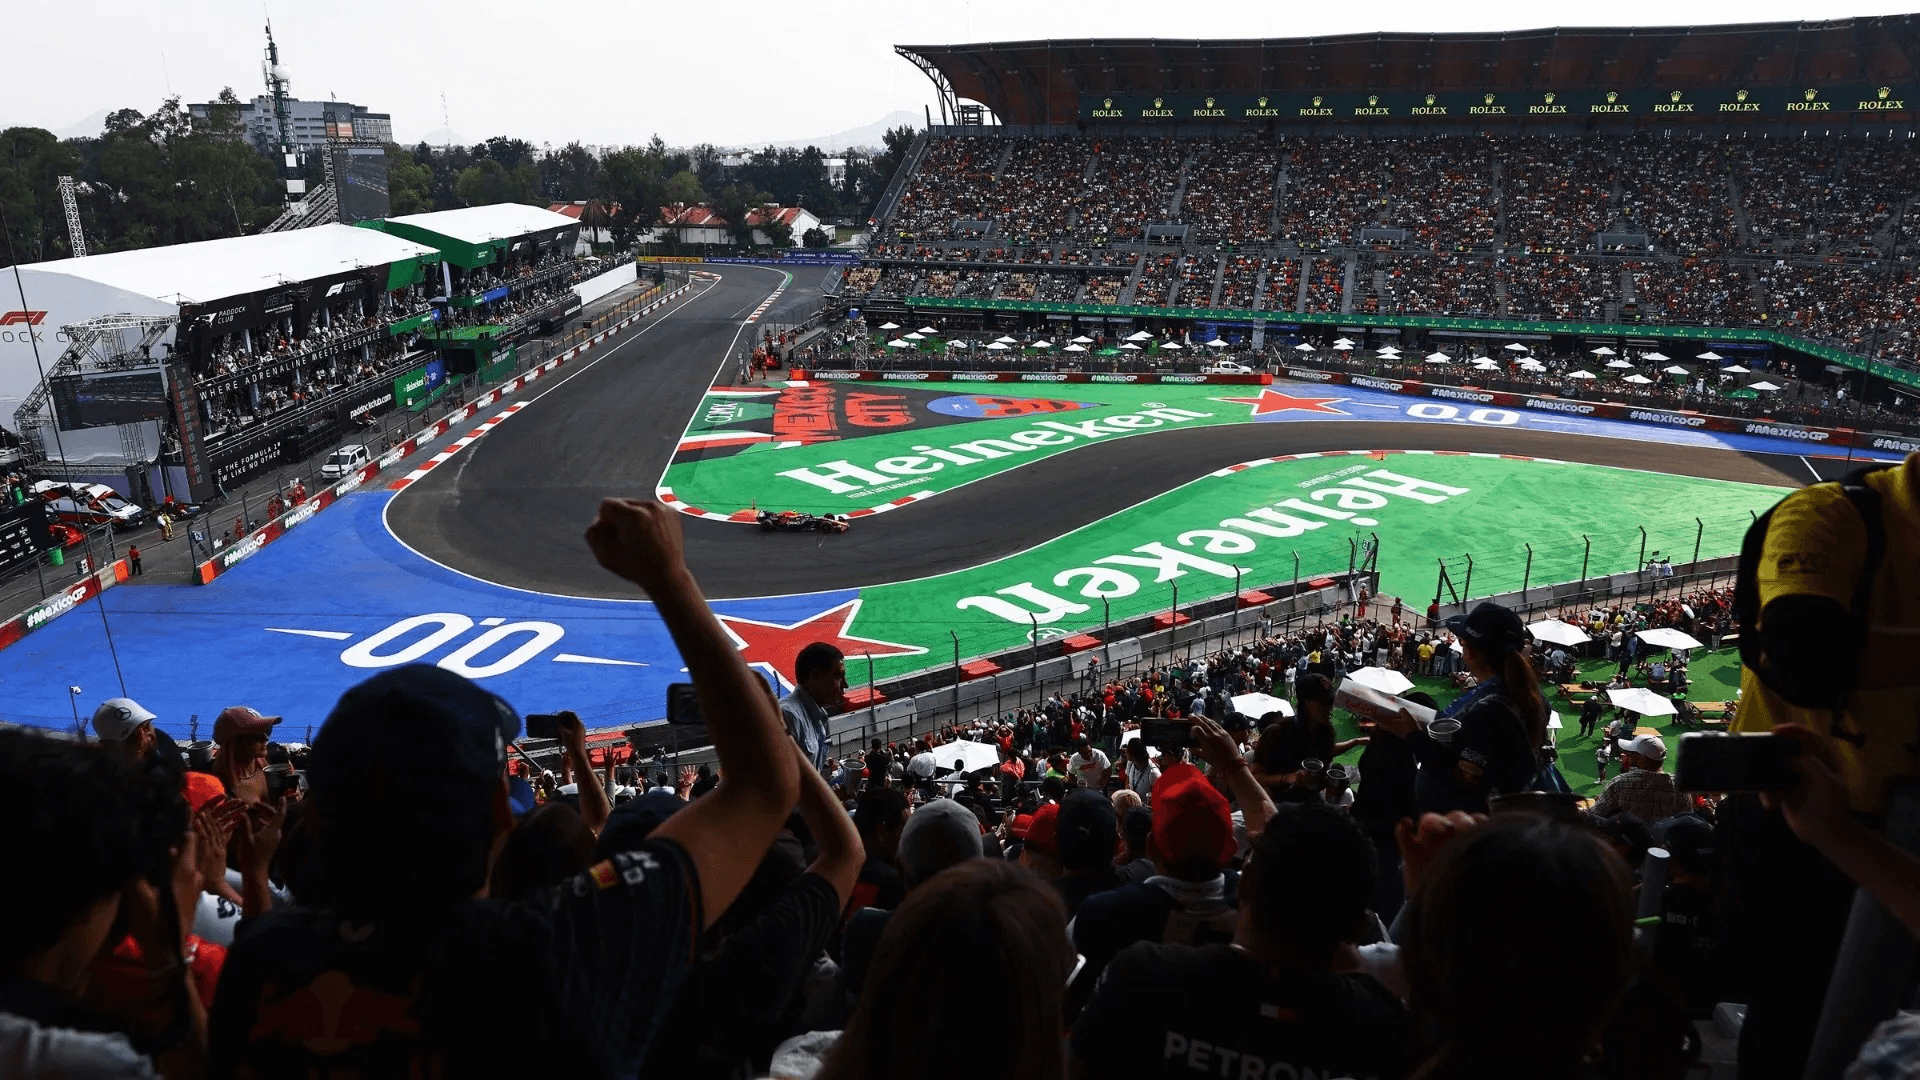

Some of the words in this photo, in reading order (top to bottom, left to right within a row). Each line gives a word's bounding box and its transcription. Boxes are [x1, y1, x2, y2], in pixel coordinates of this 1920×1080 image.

[1529, 106, 1567, 114] ROLEX
[1590, 105, 1630, 113] ROLEX
[1654, 104, 1694, 113] ROLEX
[1719, 103, 1760, 112] ROLEX
[1786, 102, 1830, 111] ROLEX
[1858, 101, 1904, 110] ROLEX
[1092, 109, 1123, 117] ROLEX
[1142, 109, 1174, 117] ROLEX
[1193, 109, 1226, 117] ROLEX
[1246, 109, 1279, 117] ROLEX
[1299, 108, 1333, 116] ROLEX
[1355, 107, 1389, 116] ROLEX
[1411, 107, 1447, 115] ROLEX
[1469, 106, 1507, 115] ROLEX
[218, 306, 246, 317] PADDOCK
[217, 315, 234, 324] CLUB
[200, 380, 239, 401] WHERE
[245, 357, 307, 385] ADRENALINE
[312, 347, 339, 360] MEETS
[343, 332, 381, 351] ELEGANCE
[814, 372, 861, 380] #MexicoGP
[1161, 375, 1208, 383] #MexicoGP
[1351, 376, 1403, 392] #MexicoGP
[1431, 387, 1494, 402] #MexicoGP
[350, 393, 392, 420] paddockclub.com
[1526, 399, 1595, 414] #MexicoGP
[1406, 403, 1520, 425] 0.0
[1630, 410, 1706, 426] #MexicoGP
[1746, 423, 1829, 441] #MexicoGP
[225, 461, 239, 473] THE
[241, 446, 272, 465] FORMULA
[231, 465, 247, 478] LIKE
[249, 460, 258, 470] NO
[260, 449, 281, 464] OTHER
[284, 499, 321, 529] #MexicoGP
[223, 532, 266, 567] #MexicoGP
[26, 585, 87, 628] #MexicoGP
[340, 612, 565, 679] 0.0
